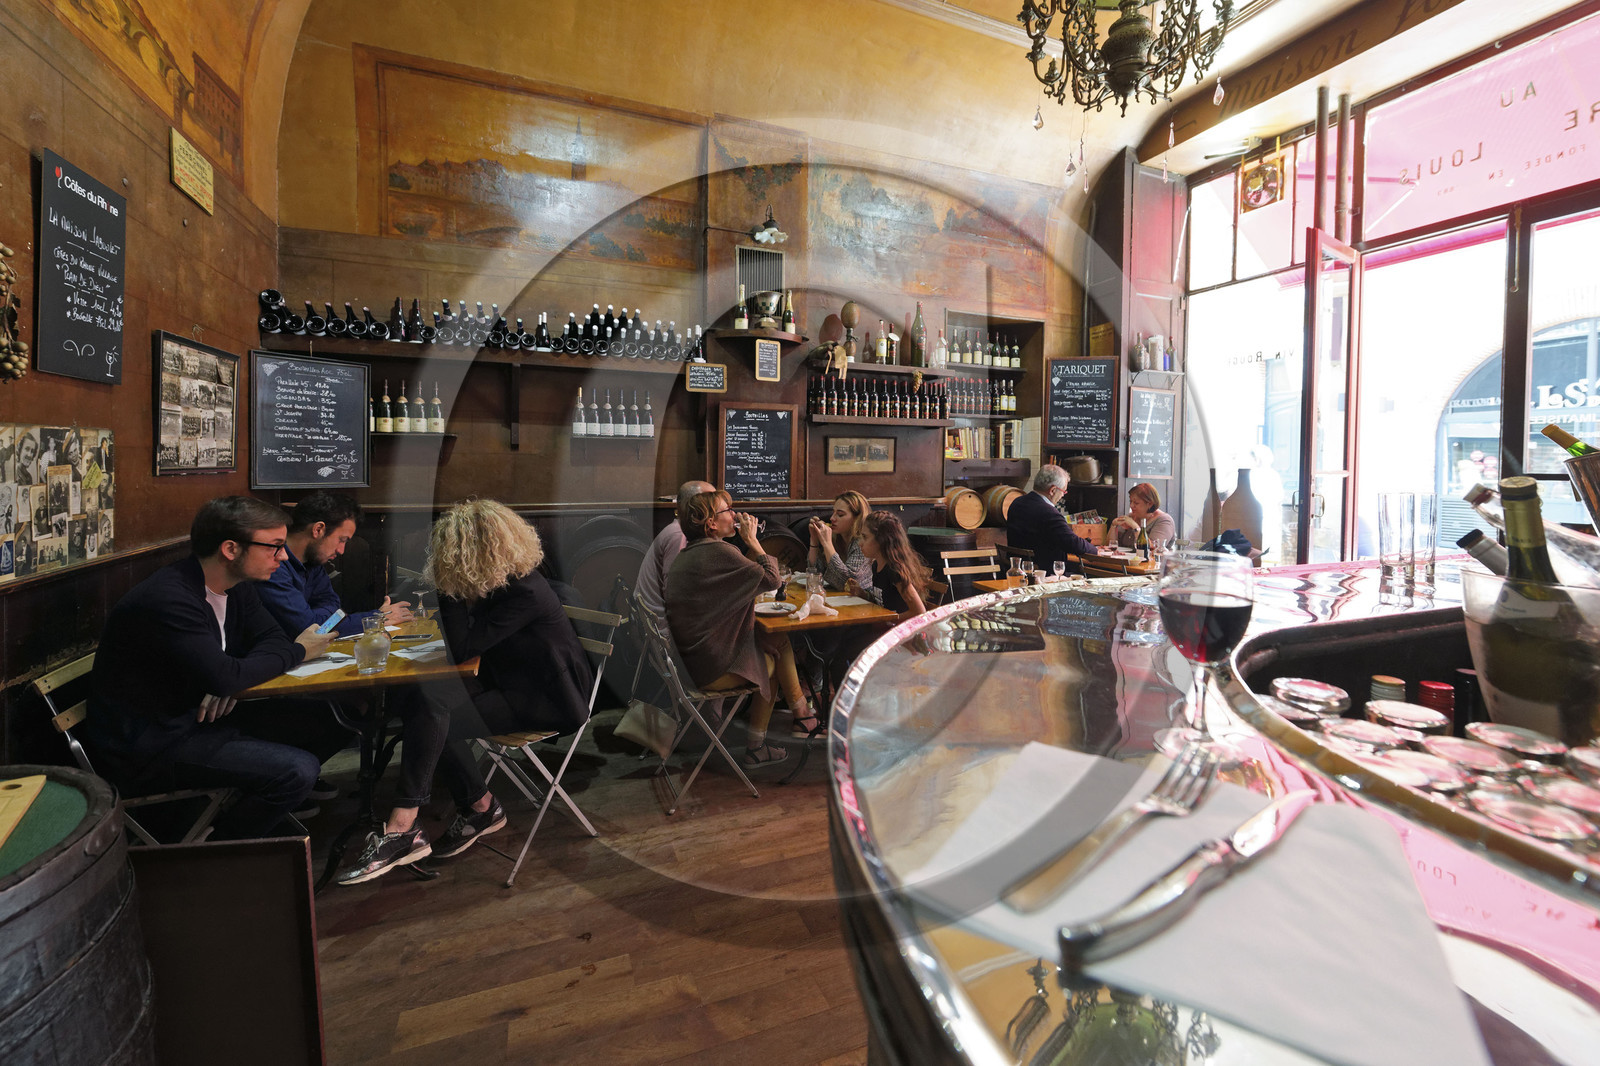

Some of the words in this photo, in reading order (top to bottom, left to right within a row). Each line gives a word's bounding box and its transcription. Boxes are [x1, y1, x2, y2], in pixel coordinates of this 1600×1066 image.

[63, 175, 86, 199] Côtes
[87, 190, 97, 205] du
[97, 195, 119, 217] Rhône
[49, 206, 59, 226] LA
[1058, 364, 1107, 376] TARIQUET
